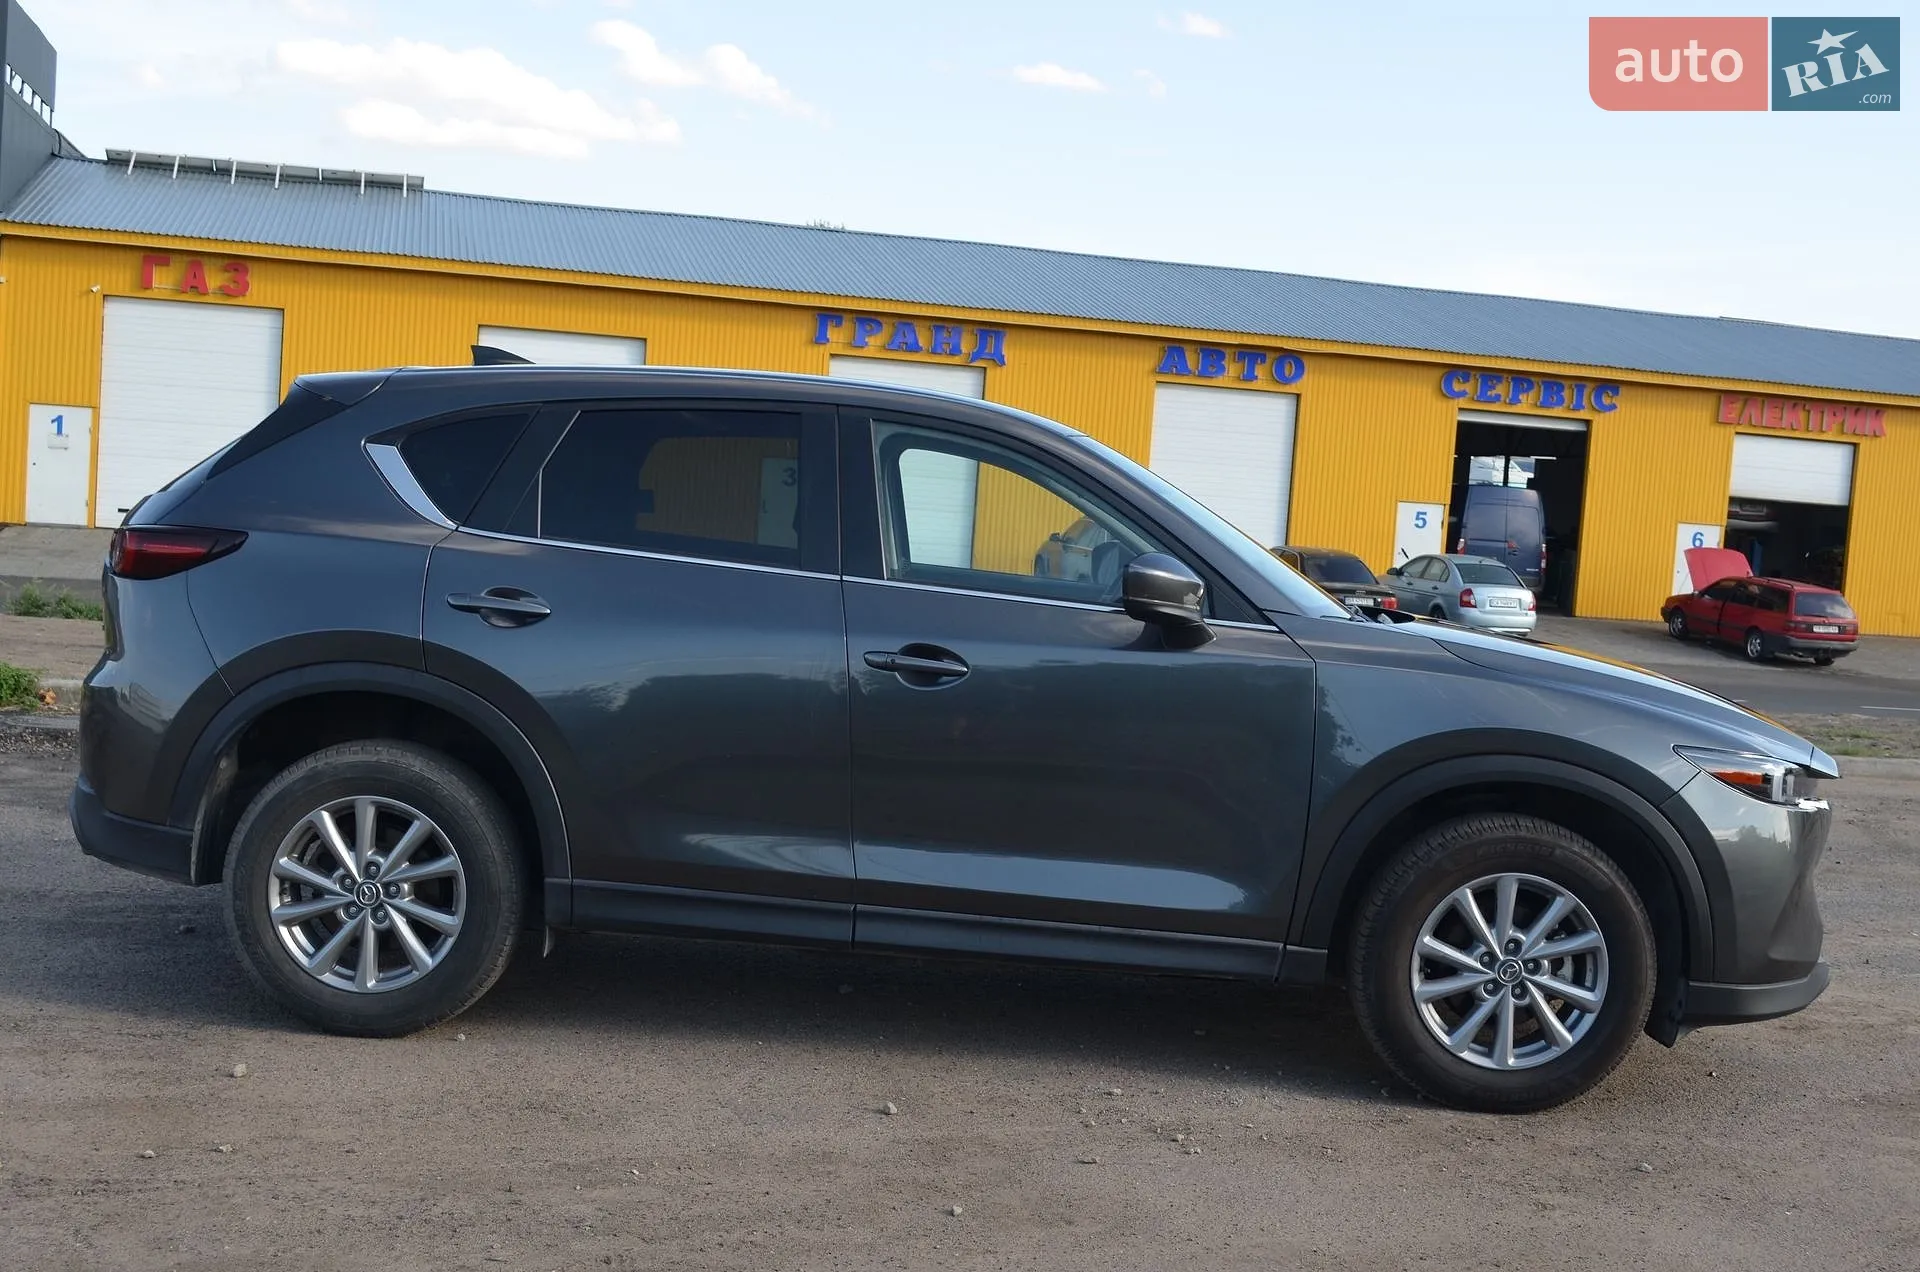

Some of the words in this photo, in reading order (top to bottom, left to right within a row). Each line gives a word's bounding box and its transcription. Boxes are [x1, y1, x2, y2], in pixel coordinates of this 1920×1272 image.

[141, 255, 250, 297] ГАЗ
[814, 312, 1008, 367] ГРАНД
[1157, 344, 1306, 385] АВТО
[1441, 369, 1621, 413] СЕРВІС
[50, 414, 64, 436] 1
[1717, 394, 1886, 438] ЕЛЕКТРИК
[782, 467, 797, 487] 3
[1414, 511, 1428, 529] 5
[1691, 532, 1705, 548] 6
